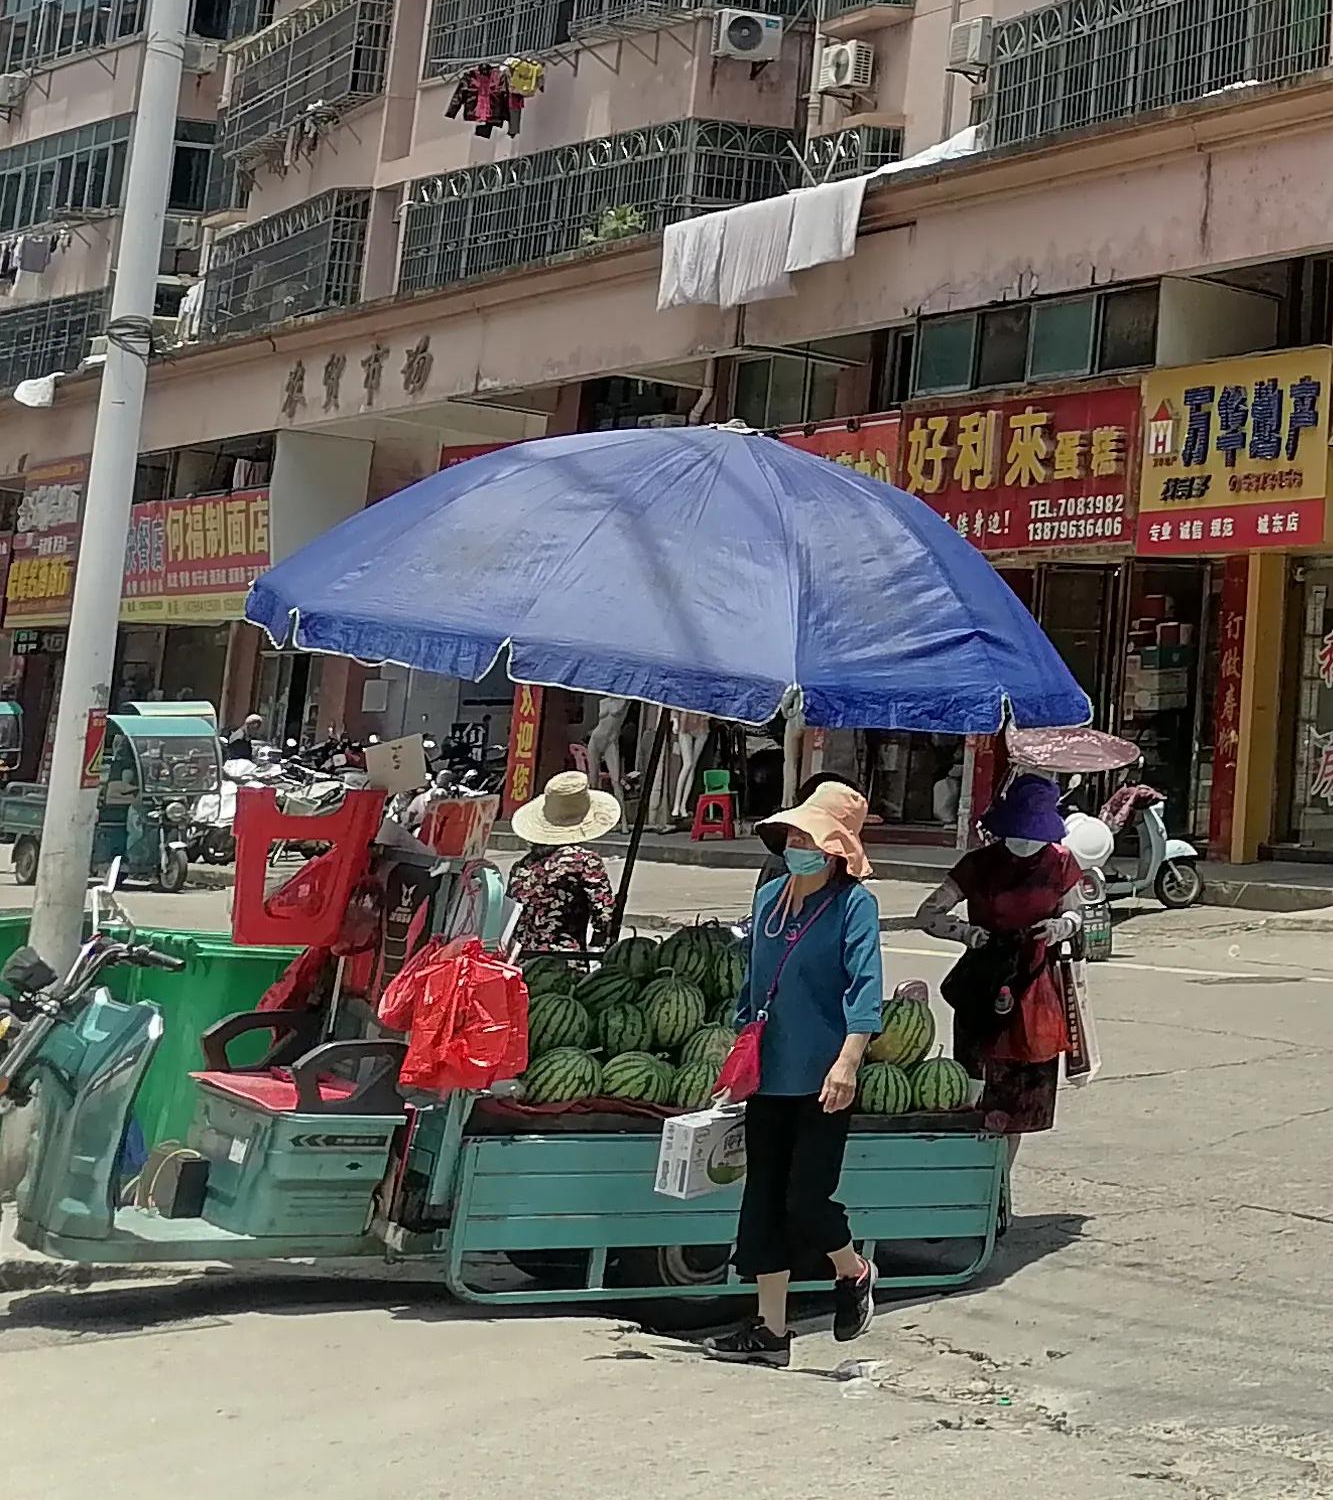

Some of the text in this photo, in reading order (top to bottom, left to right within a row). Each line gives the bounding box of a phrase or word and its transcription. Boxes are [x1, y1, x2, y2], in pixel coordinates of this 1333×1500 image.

[1180, 374, 1322, 469] 万华地产
[1028, 494, 1125, 520] TEL:7083982
[1027, 516, 1123, 542] 13879636406
[1149, 521, 1172, 542] 专业
[1179, 519, 1203, 540] 诚信
[1257, 512, 1300, 535] 城东店
